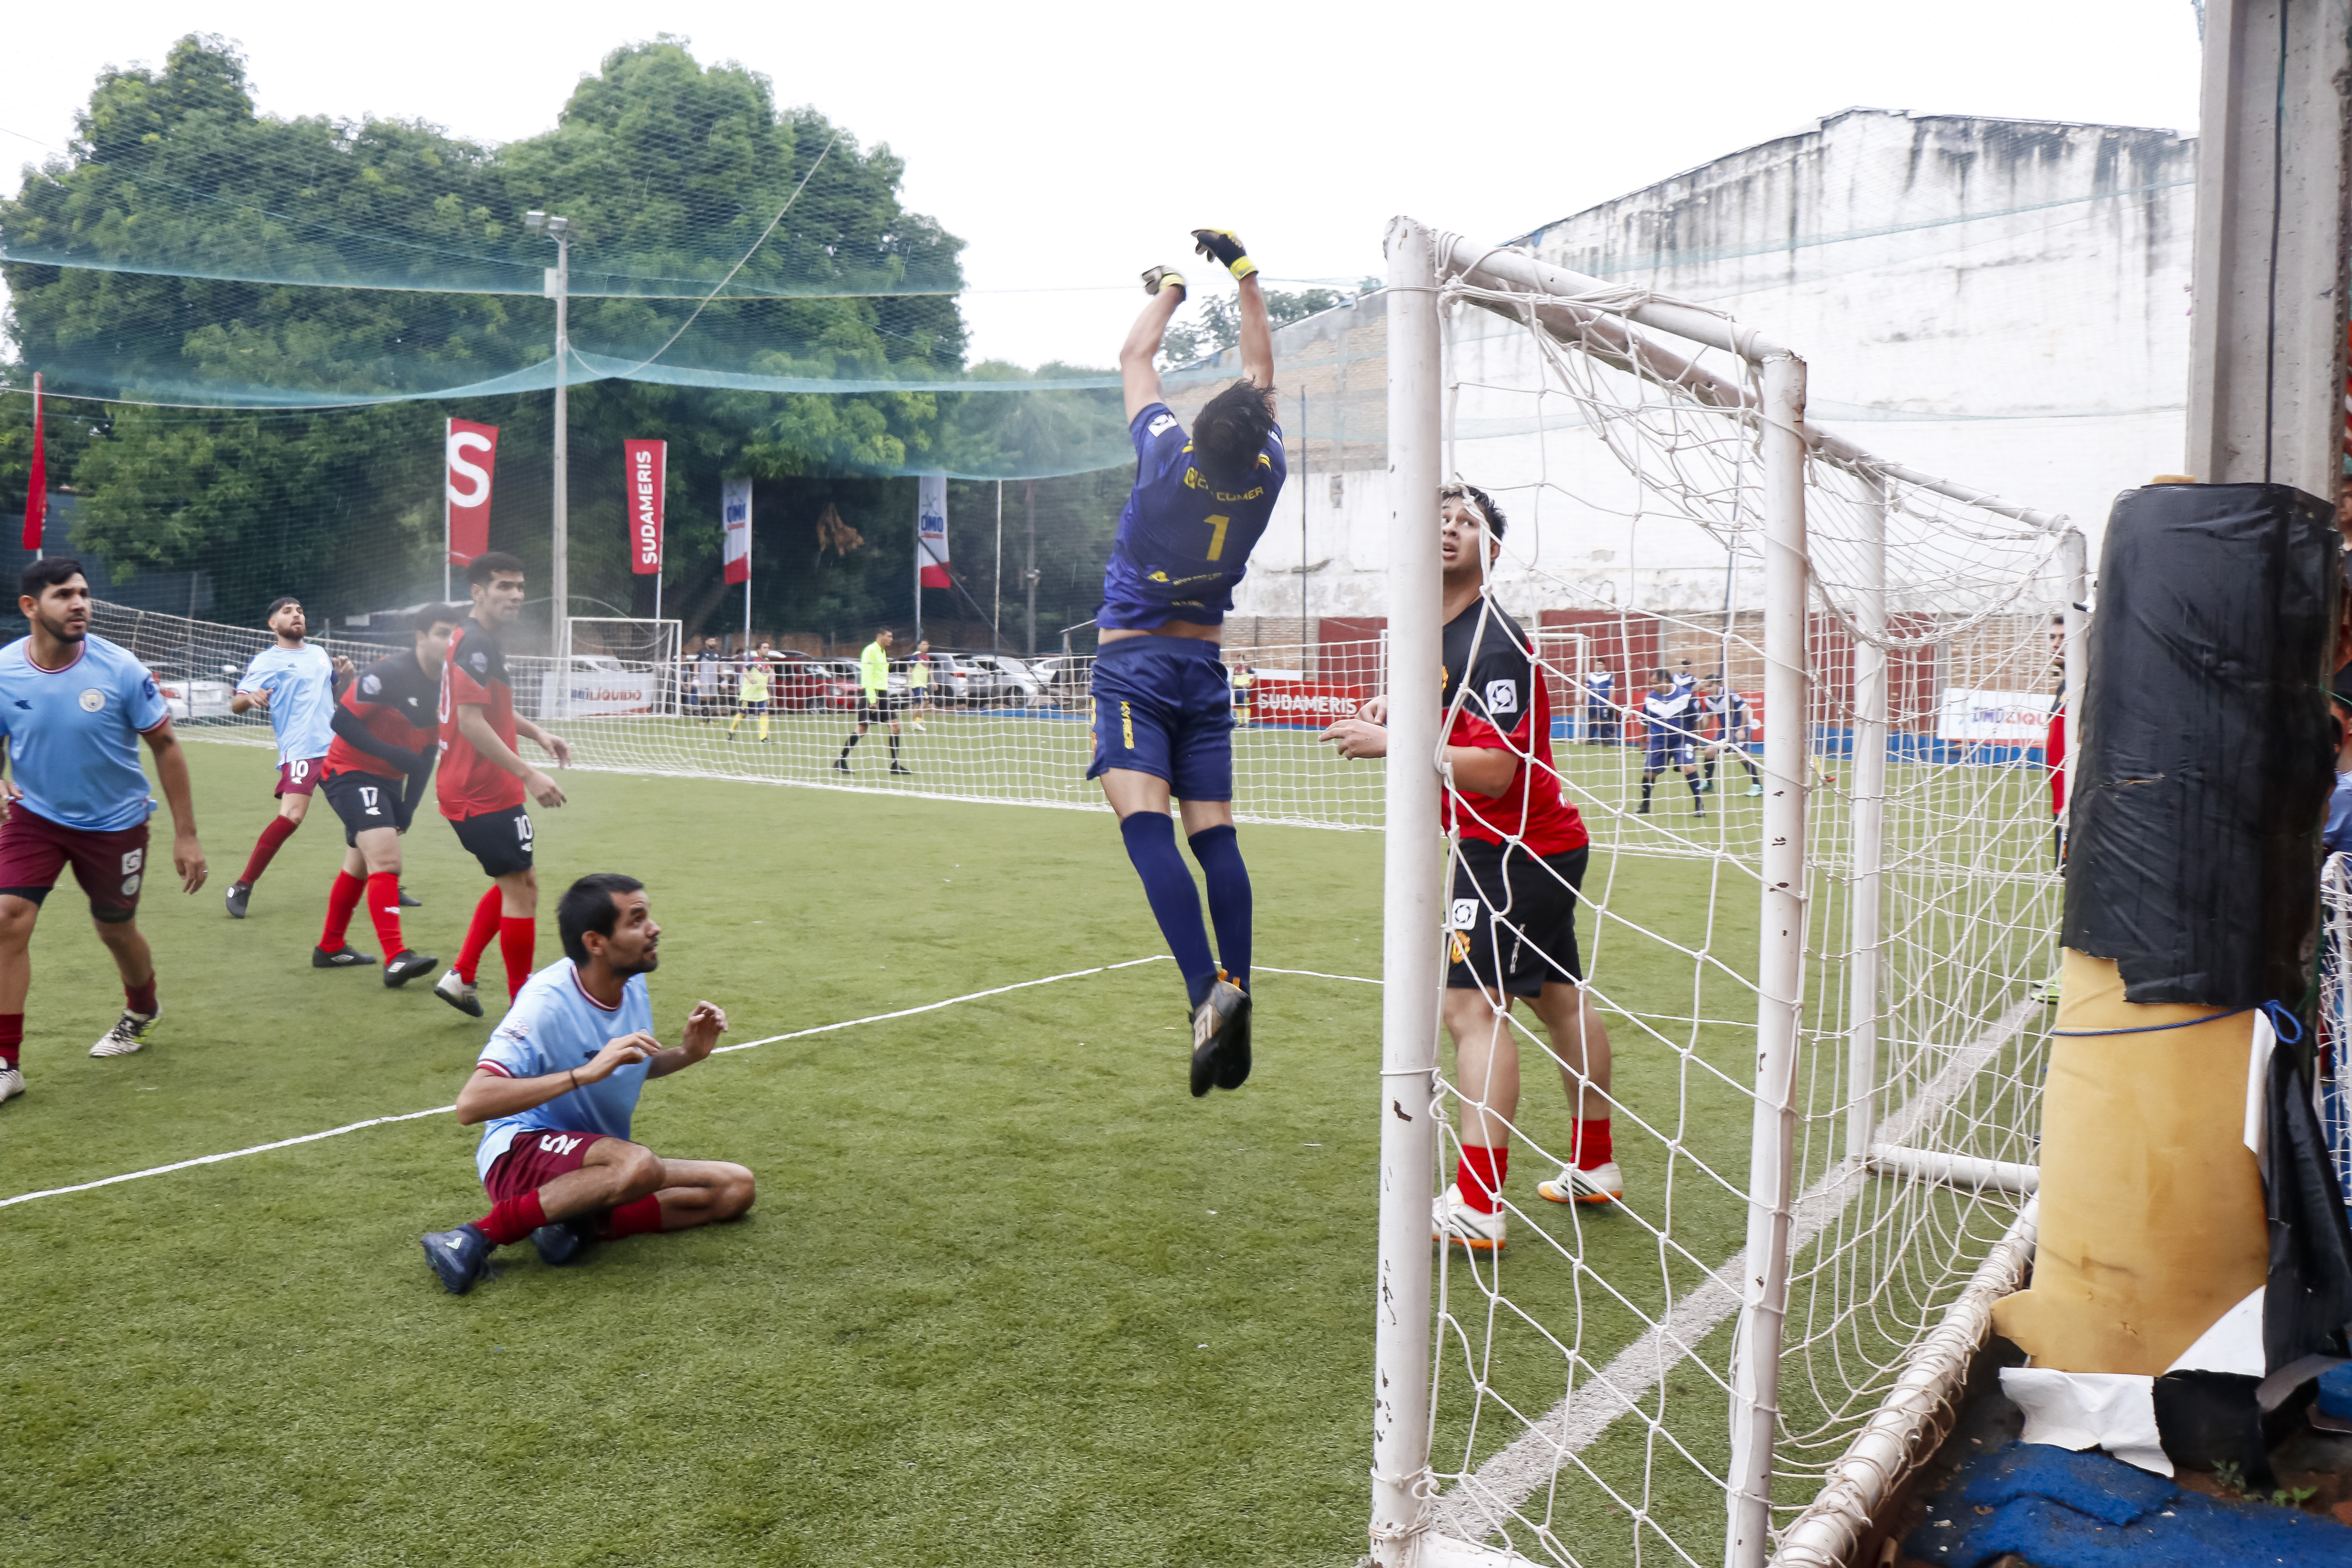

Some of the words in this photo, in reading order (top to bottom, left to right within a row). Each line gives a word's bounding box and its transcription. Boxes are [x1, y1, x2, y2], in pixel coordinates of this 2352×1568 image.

[446, 432, 492, 508] S
[635, 450, 658, 564] SUDAMERIS
[1203, 514, 1230, 561] 1
[1257, 693, 1357, 714] SUDAMERIS
[290, 760, 309, 778] 10
[358, 786, 379, 808] 17
[513, 815, 533, 841] 10
[539, 1134, 568, 1153] 5
